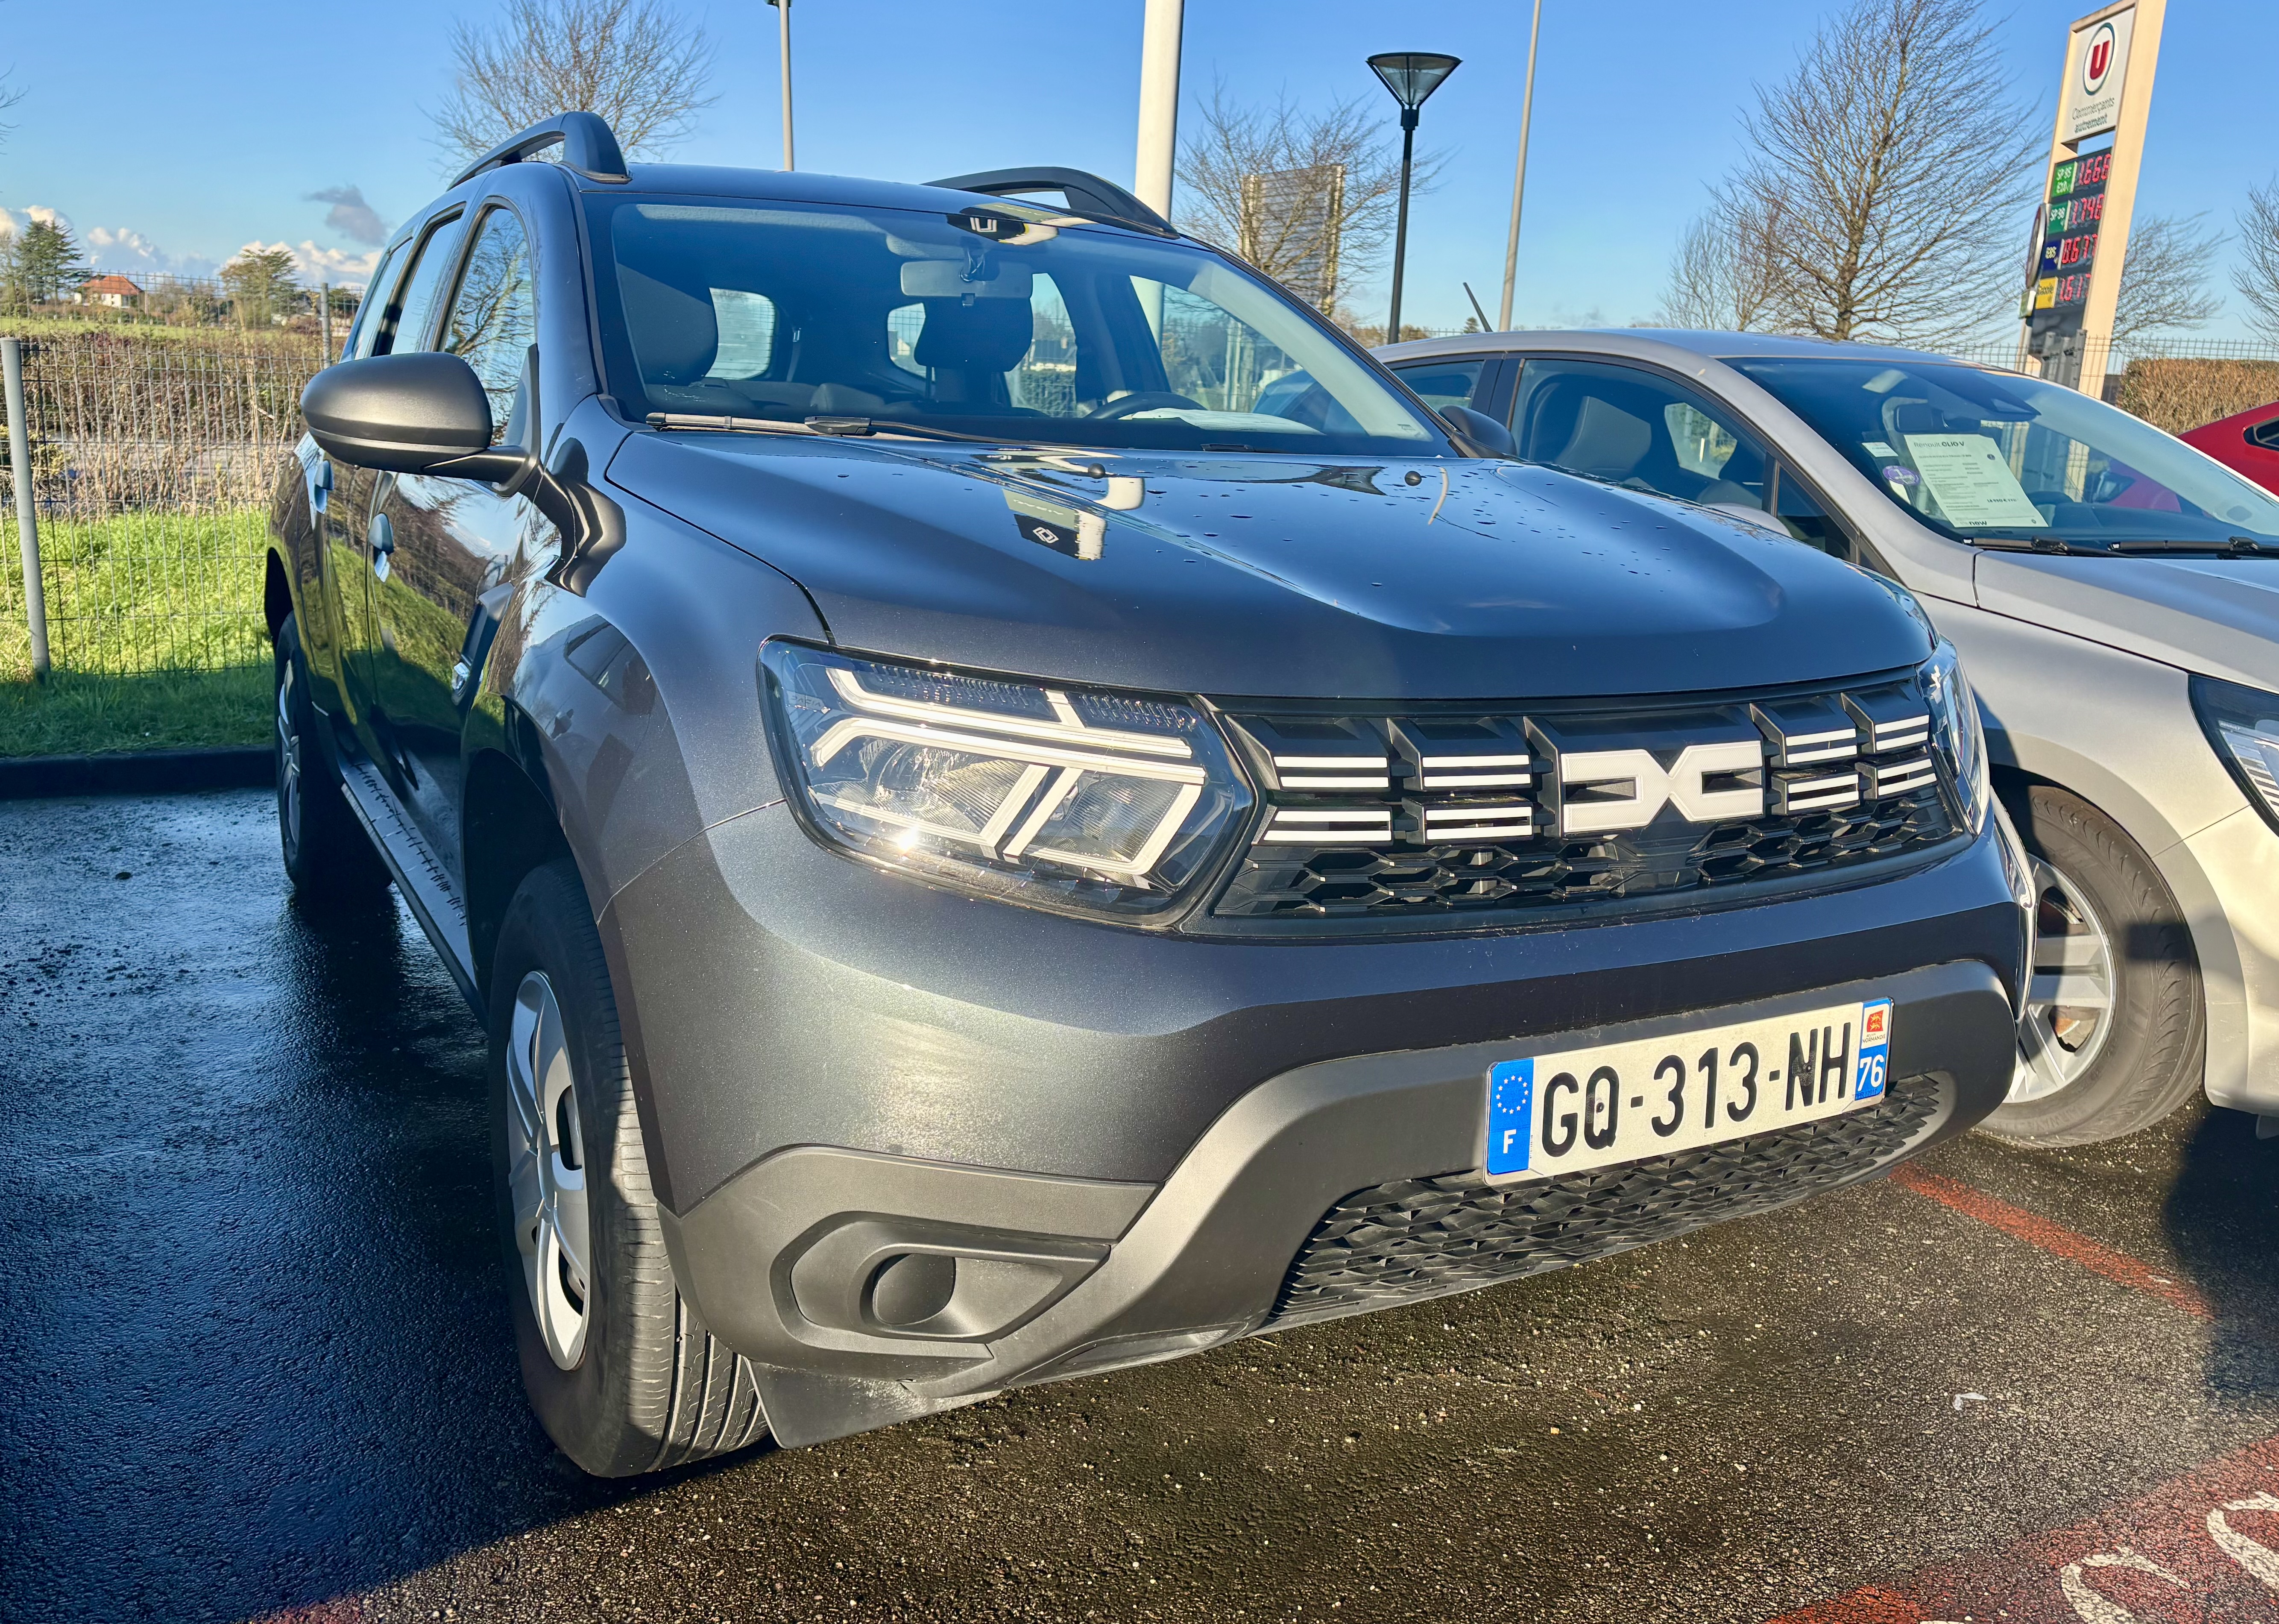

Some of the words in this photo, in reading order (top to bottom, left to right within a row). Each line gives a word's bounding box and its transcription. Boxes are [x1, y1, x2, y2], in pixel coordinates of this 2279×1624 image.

[2090, 40, 2110, 80] U
[1541, 1022, 1851, 1157] GQ-313-NH
[1857, 1055, 1884, 1091] 76
[1503, 1129, 1517, 1154] F
